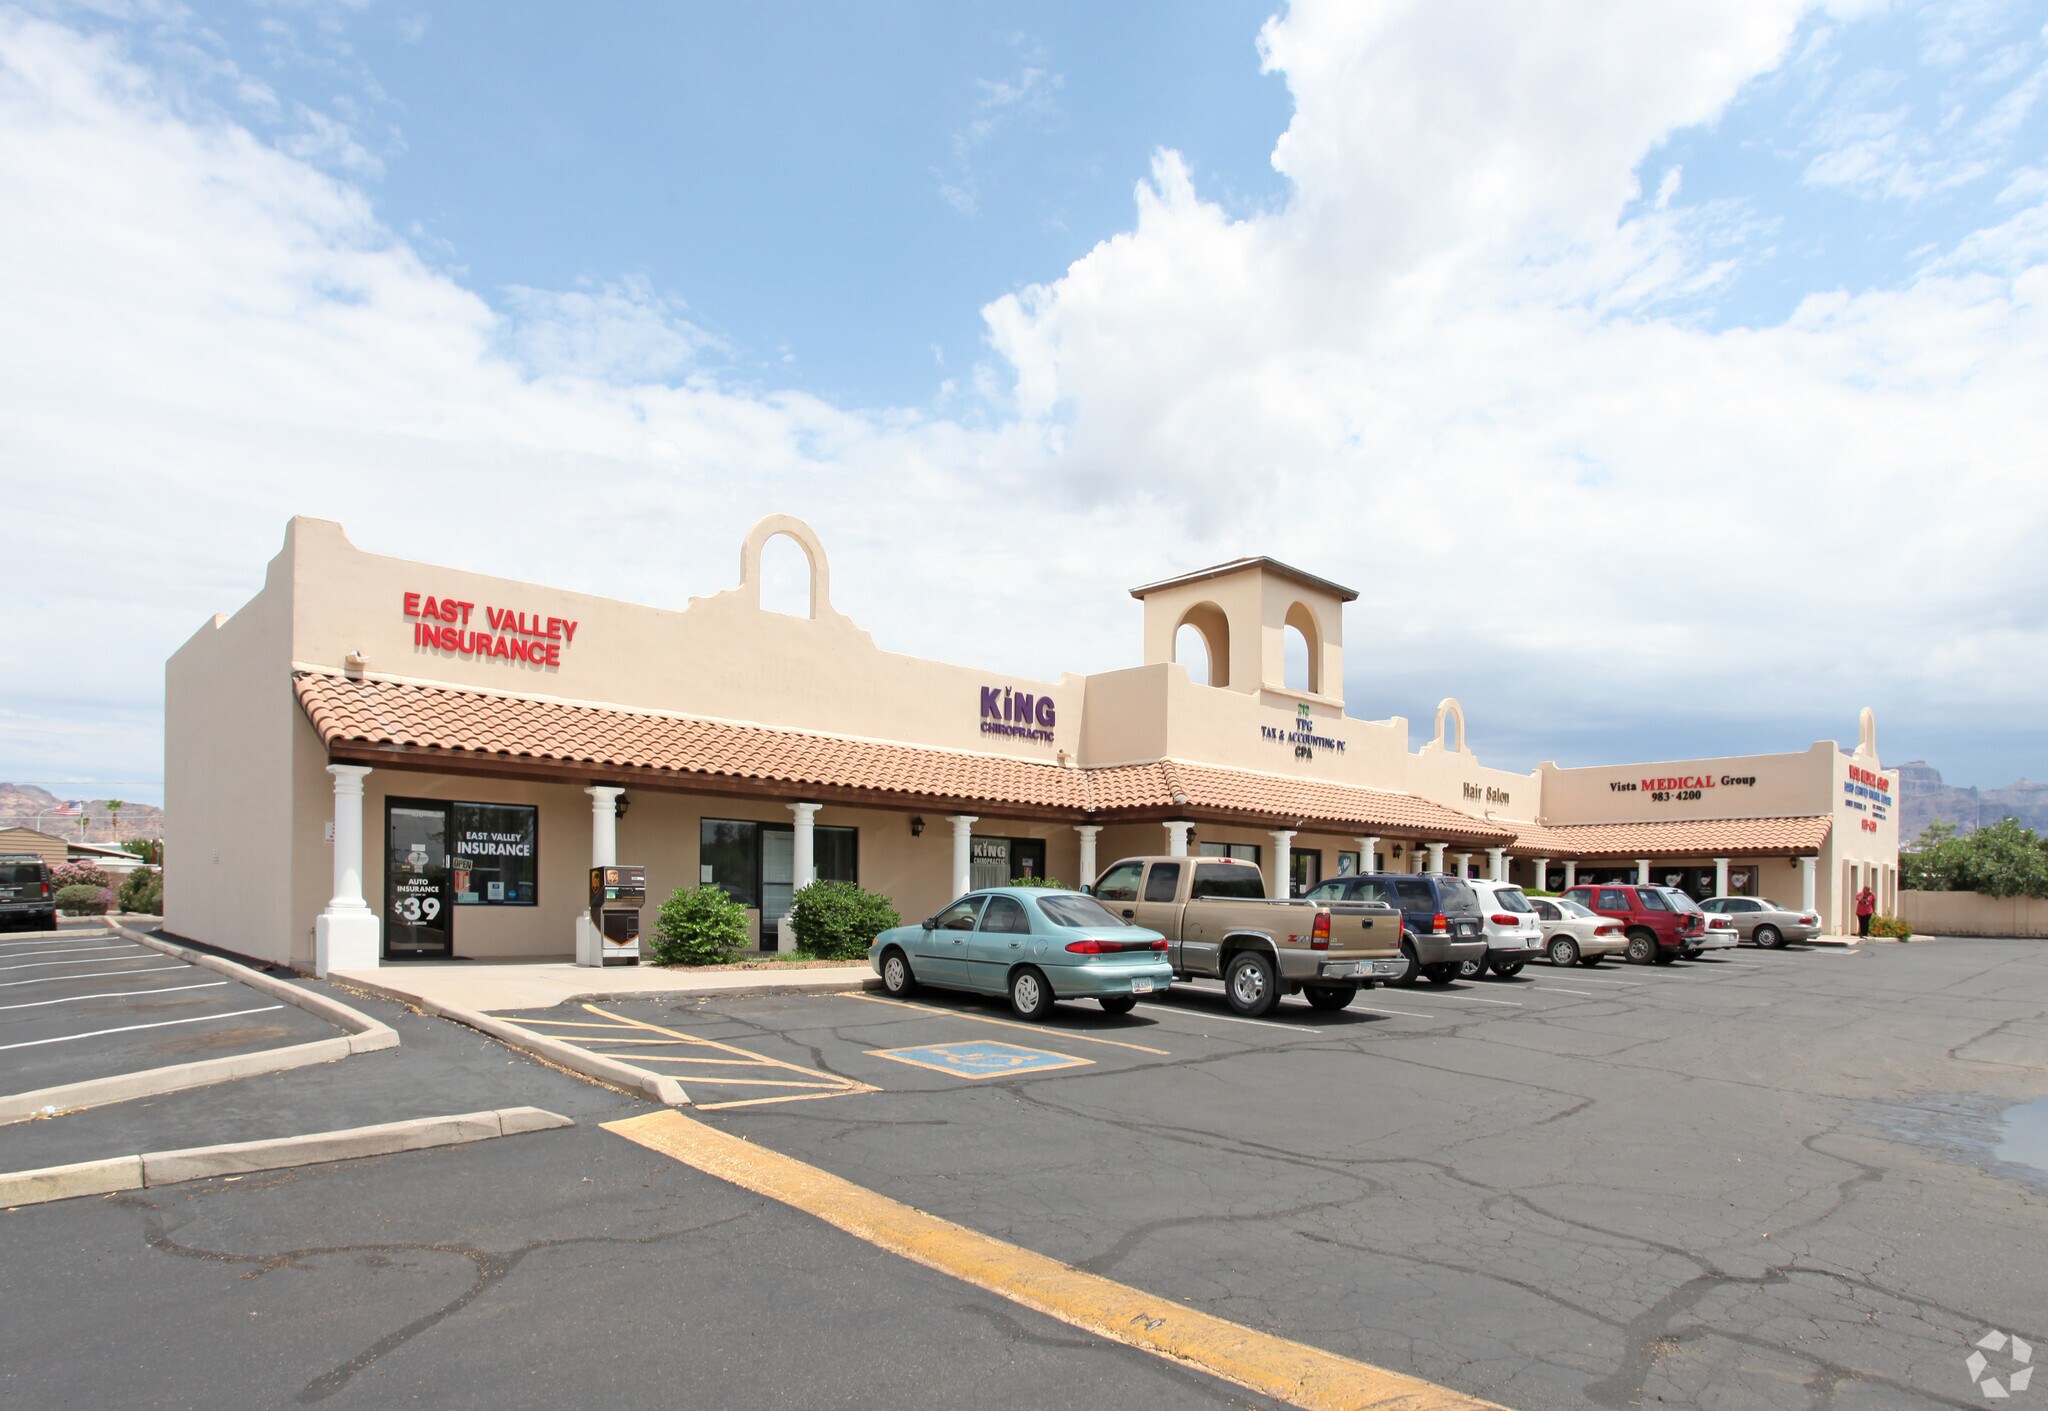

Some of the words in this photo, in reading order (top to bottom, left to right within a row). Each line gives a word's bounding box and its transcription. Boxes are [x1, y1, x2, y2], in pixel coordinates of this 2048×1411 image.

[404, 591, 475, 625] EAST
[486, 606, 578, 642] VALLEY
[414, 622, 561, 667] INSURANCE
[980, 721, 1055, 743] CHIROPRACTIC
[1295, 717, 1313, 732] TPG
[1260, 725, 1277, 739] TAX
[1278, 729, 1285, 740] &
[1287, 731, 1335, 749] ACCOUNTING
[1336, 740, 1346, 751] PC
[1294, 745, 1313, 759] CPA
[1610, 782, 1637, 792] Vista
[1640, 775, 1716, 792] MEDICAL
[1720, 775, 1756, 787] Group
[1463, 782, 1482, 799] Hair
[1486, 786, 1510, 804] Salon
[1651, 790, 1702, 802] 983-4200
[466, 831, 488, 841] EAST
[491, 832, 522, 842] VALLEY
[457, 841, 530, 857] INSURANCE
[454, 858, 472, 869] OPEN
[973, 857, 1006, 865] CHIROPRACTIC
[397, 885, 440, 893] INSURANCE
[394, 897, 441, 921] $39
